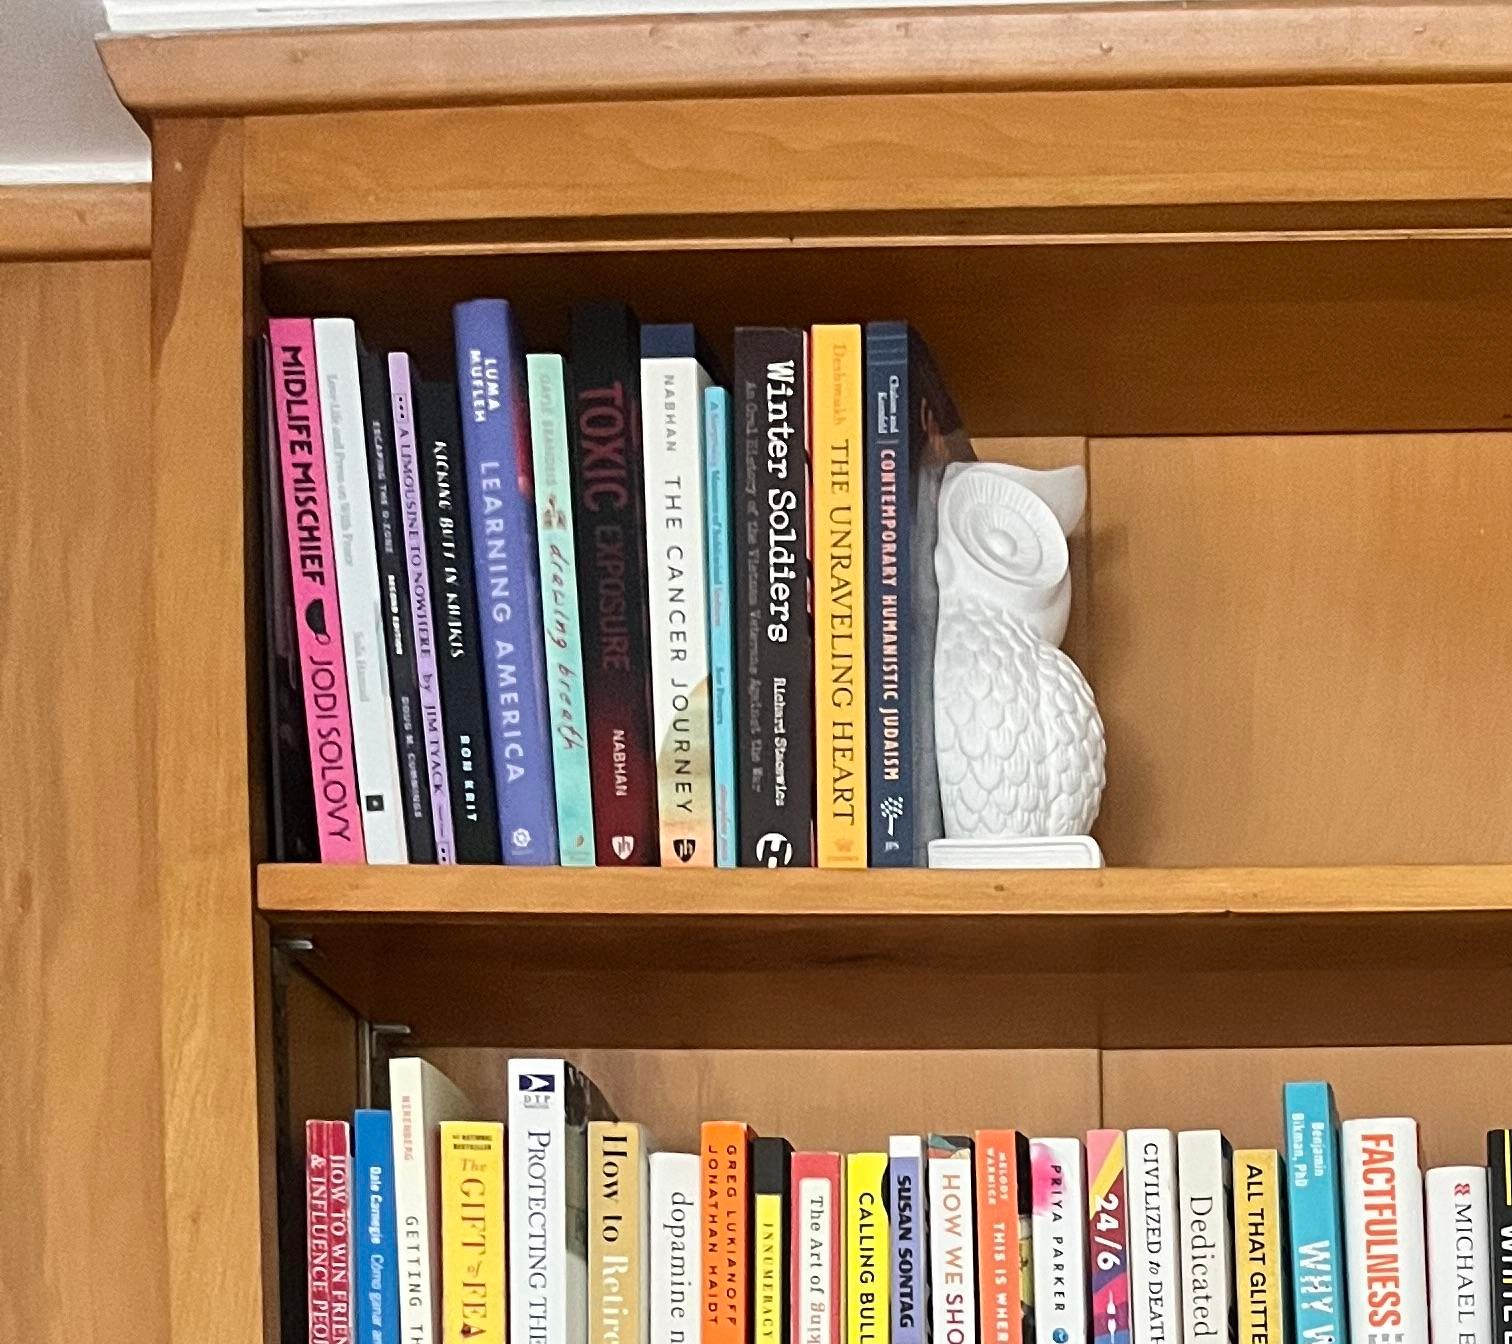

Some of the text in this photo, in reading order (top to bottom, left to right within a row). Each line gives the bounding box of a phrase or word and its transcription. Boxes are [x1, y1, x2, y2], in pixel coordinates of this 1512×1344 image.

[281, 345, 324, 585] MIDLIFE MISCHIEF
[766, 360, 796, 642] Winter Soldiers
[480, 461, 524, 783] LEARNING AMERICA
[665, 476, 694, 813] THE CANCER JOURNEY
[829, 439, 854, 826] THE UNRAVELING HEART
[879, 449, 899, 781] CONTEMPORARY HUMANISTIC JUDAISM
[308, 656, 349, 841] JODI SOLOVY
[611, 729, 628, 796] NABHAN
[526, 1130, 551, 1289] PROTECTING
[601, 1135, 627, 1201] How
[601, 1215, 624, 1243] to
[859, 1192, 875, 1284] CALLING
[1247, 1164, 1265, 1202] ALL
[1248, 1208, 1266, 1265] THAT
[1362, 1133, 1402, 1328] FACTFULNESS
[898, 1175, 914, 1328] SUSAN SONTAG
[1189, 1195, 1215, 1338] Dedicated
[1299, 1240, 1331, 1312] WHY
